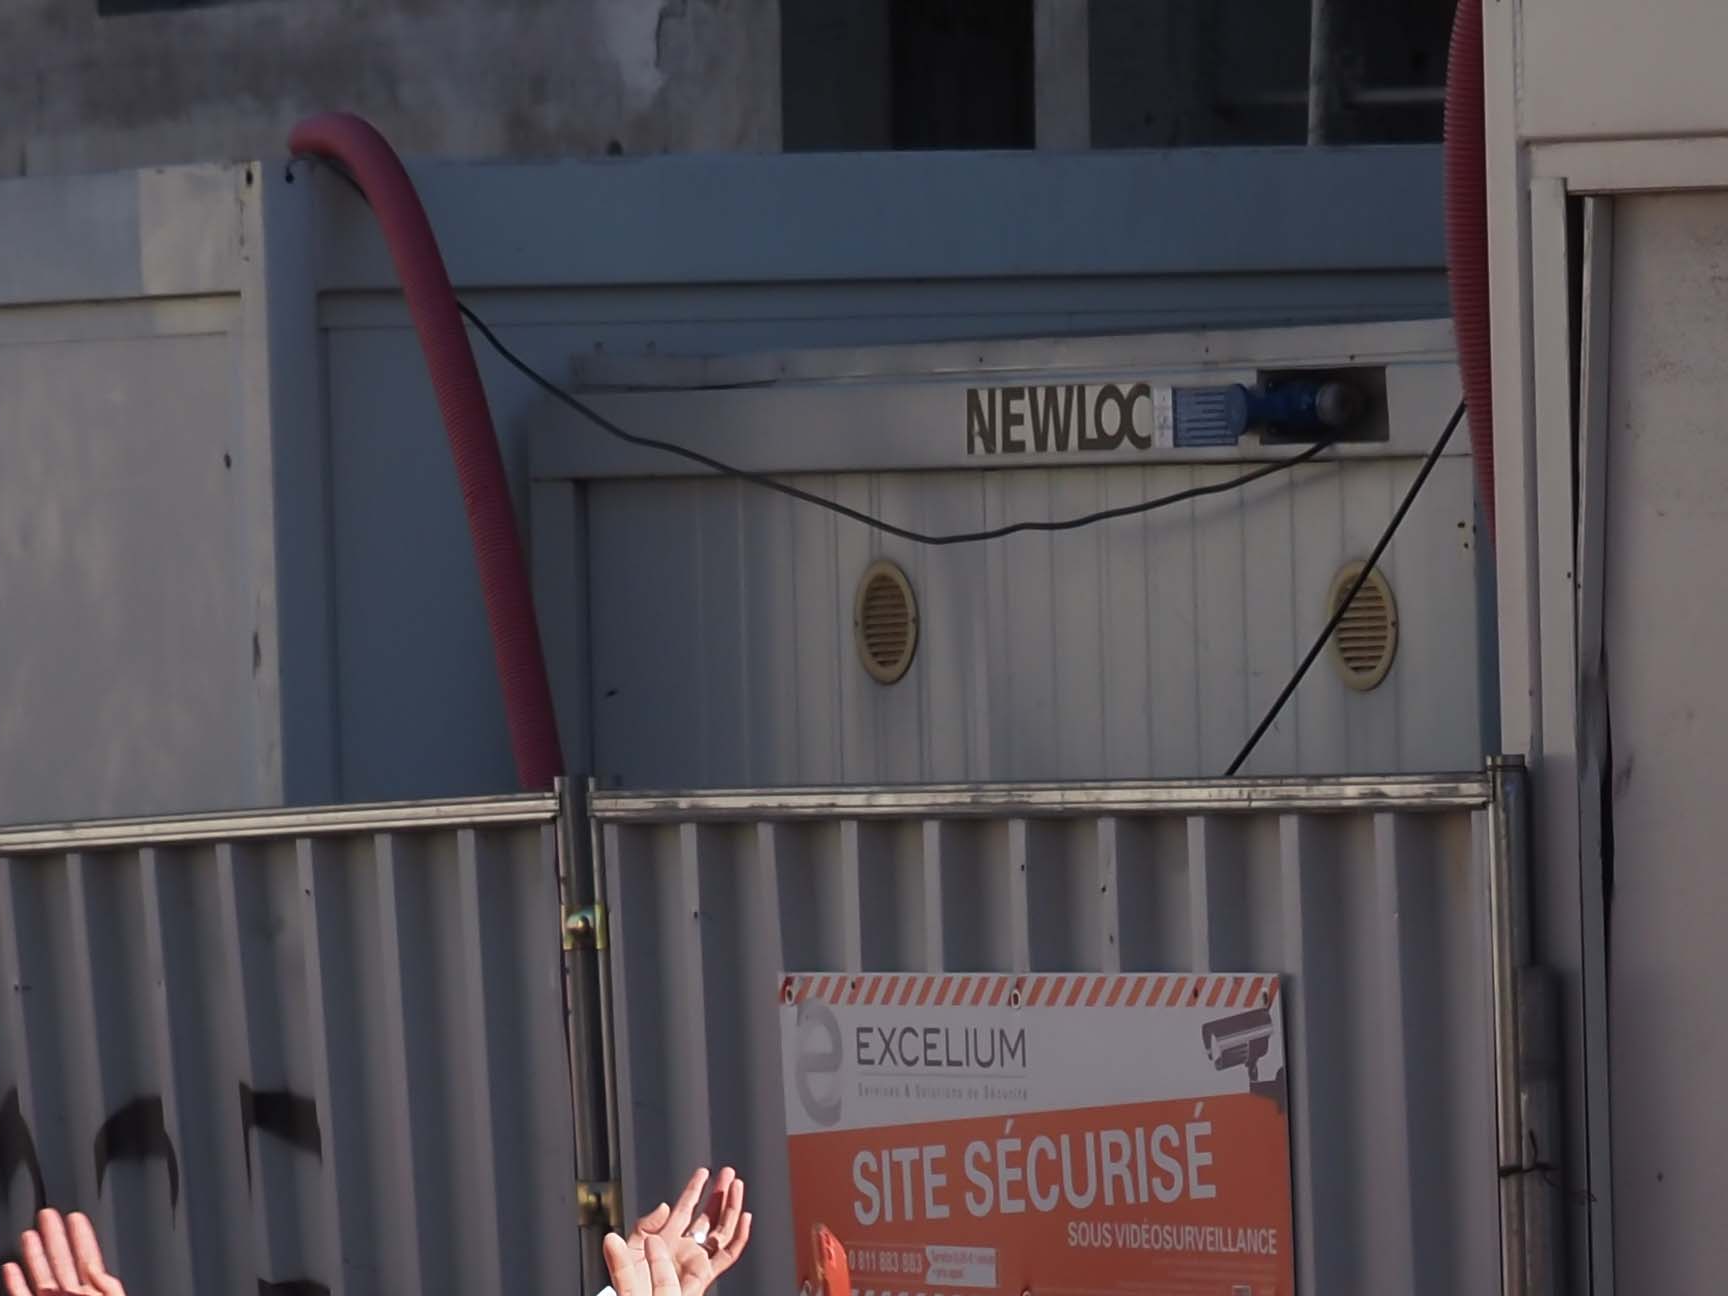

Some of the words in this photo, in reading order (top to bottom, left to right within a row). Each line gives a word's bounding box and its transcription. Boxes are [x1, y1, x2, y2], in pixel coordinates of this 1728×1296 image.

[966, 382, 1152, 455] NEWLOC
[855, 1026, 1027, 1069] EXCELIUM
[852, 1144, 949, 1226] SITE
[964, 1101, 1217, 1217] SÉCURISÉ
[1067, 1222, 1113, 1247] SOUS
